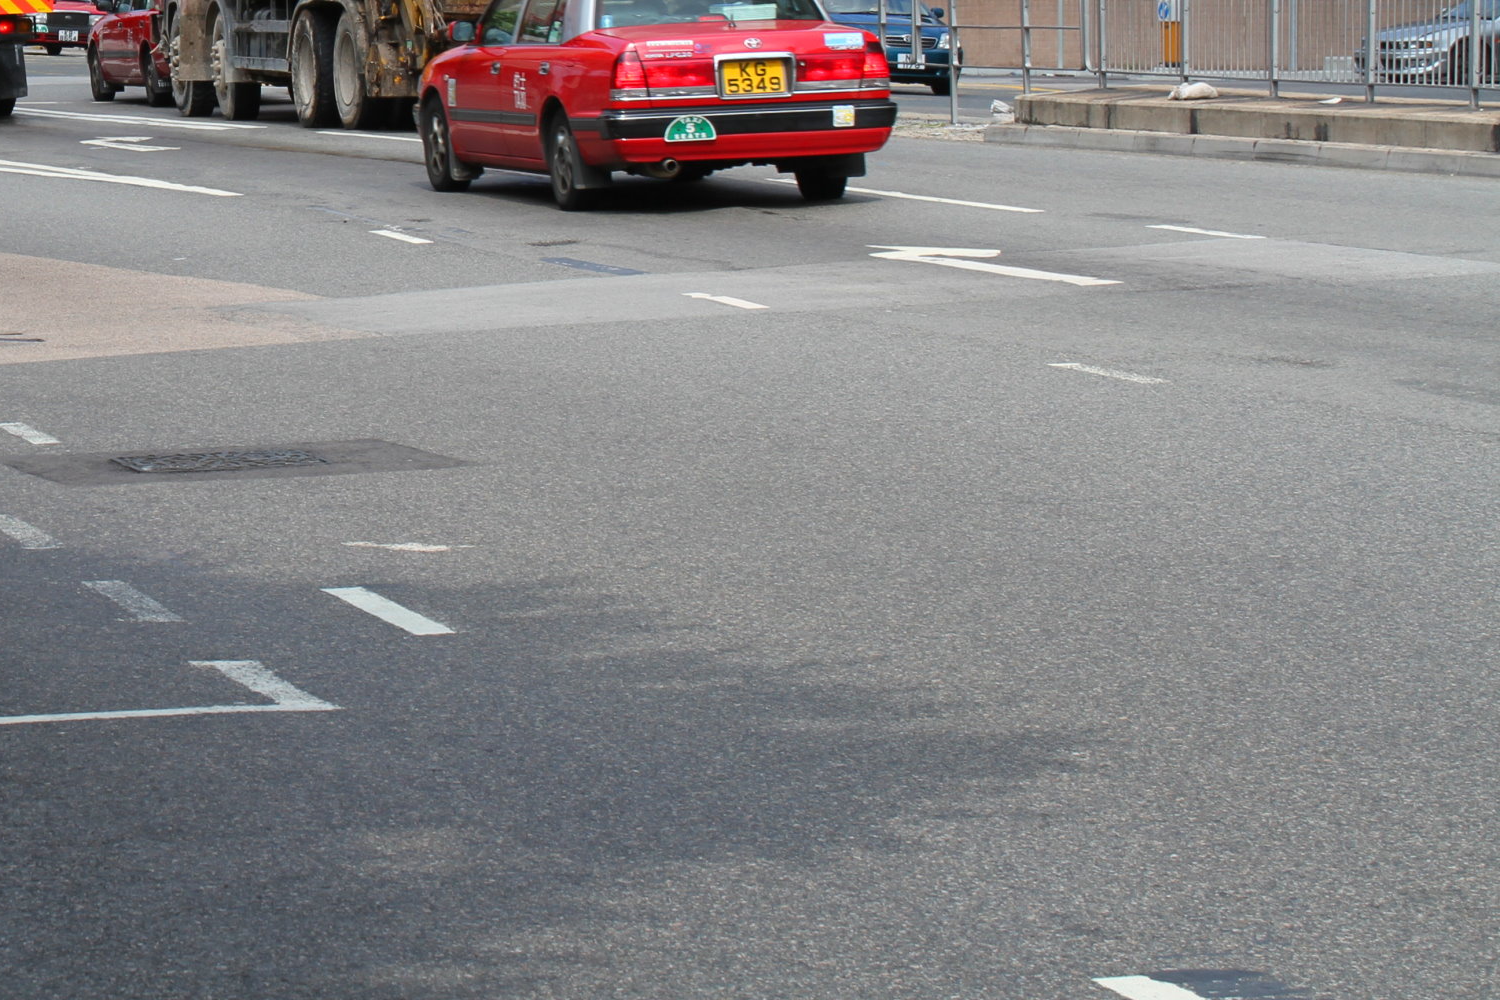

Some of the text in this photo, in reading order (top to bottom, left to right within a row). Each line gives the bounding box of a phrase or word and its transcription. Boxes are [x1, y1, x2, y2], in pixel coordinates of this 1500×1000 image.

[739, 62, 766, 77] KG
[727, 77, 782, 93] 5349
[680, 117, 703, 125] TAXI
[686, 123, 696, 133] 5
[674, 132, 707, 140] SEATS
